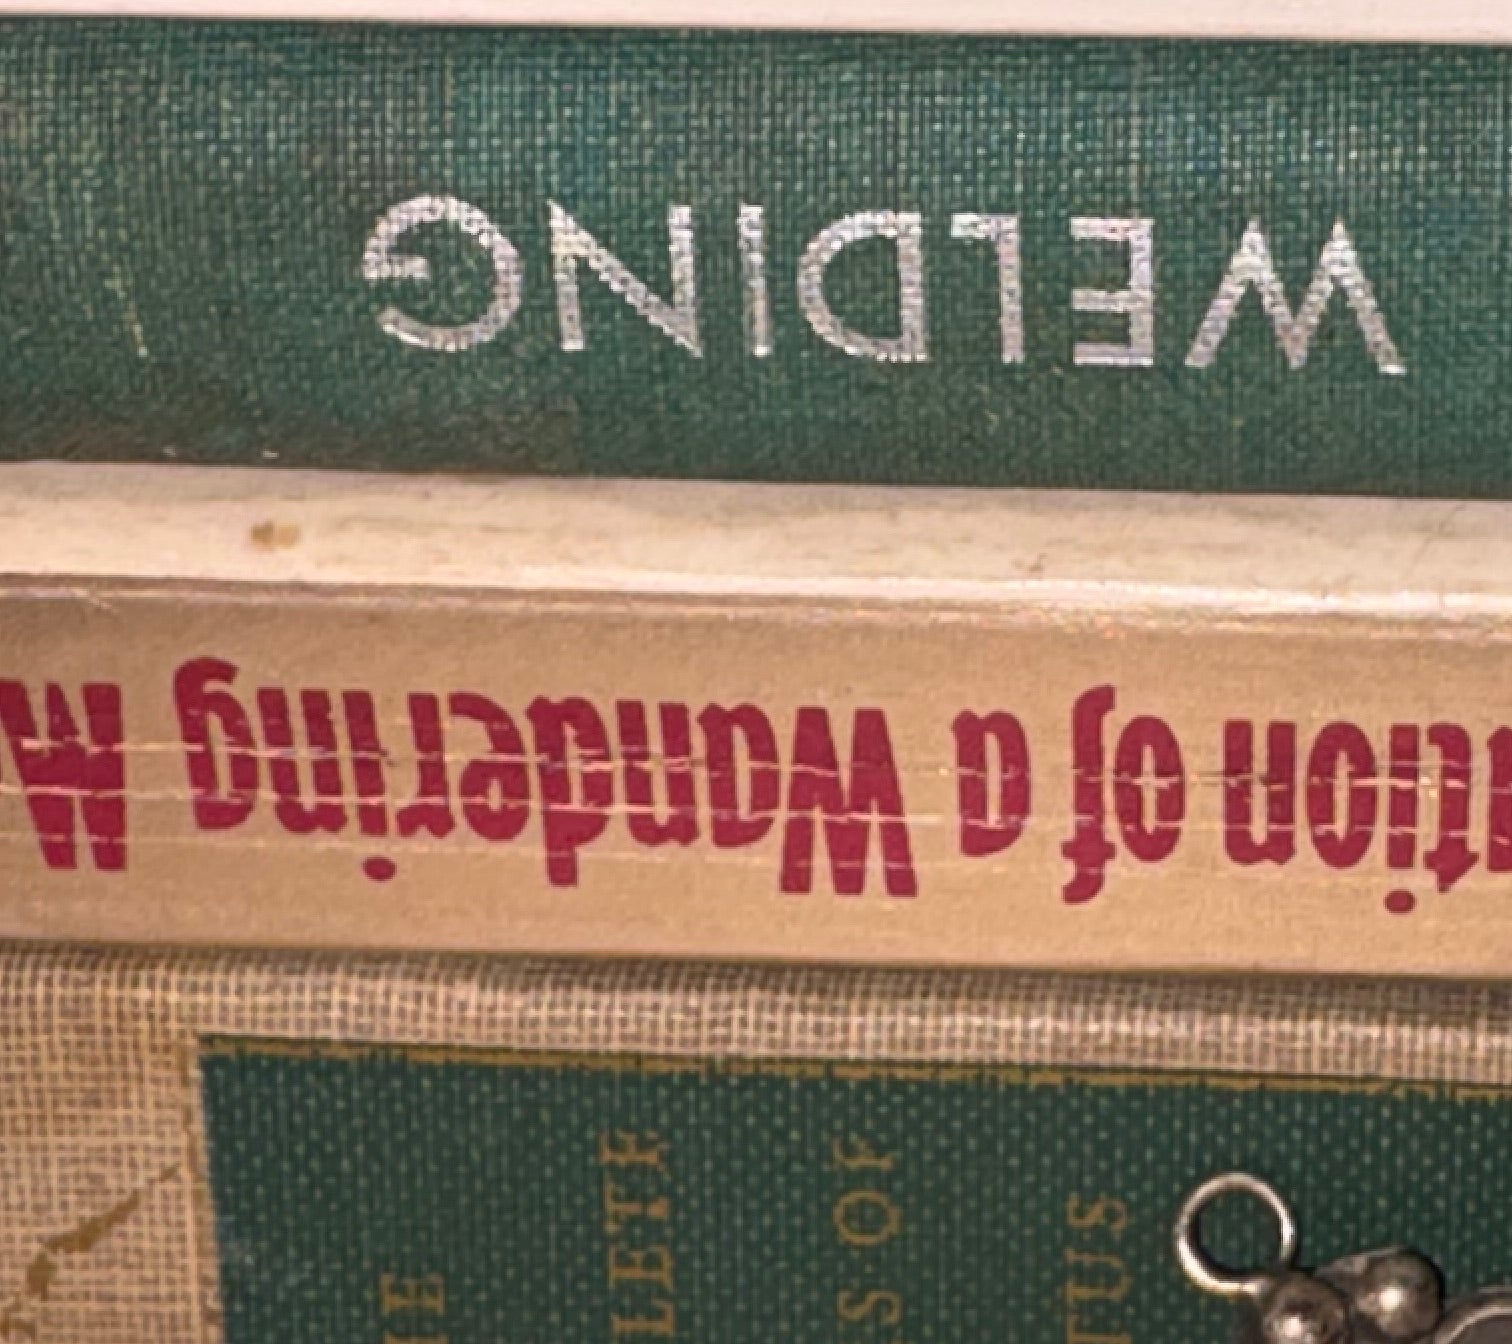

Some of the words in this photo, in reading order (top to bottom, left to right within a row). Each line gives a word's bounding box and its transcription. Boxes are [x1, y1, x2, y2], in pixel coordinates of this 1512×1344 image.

[360, 192, 1408, 377] WELDING
[173, 655, 918, 898] Wandering
[952, 709, 1032, 857] a
[1061, 684, 1185, 904] of
[832, 1136, 902, 1247] OF
